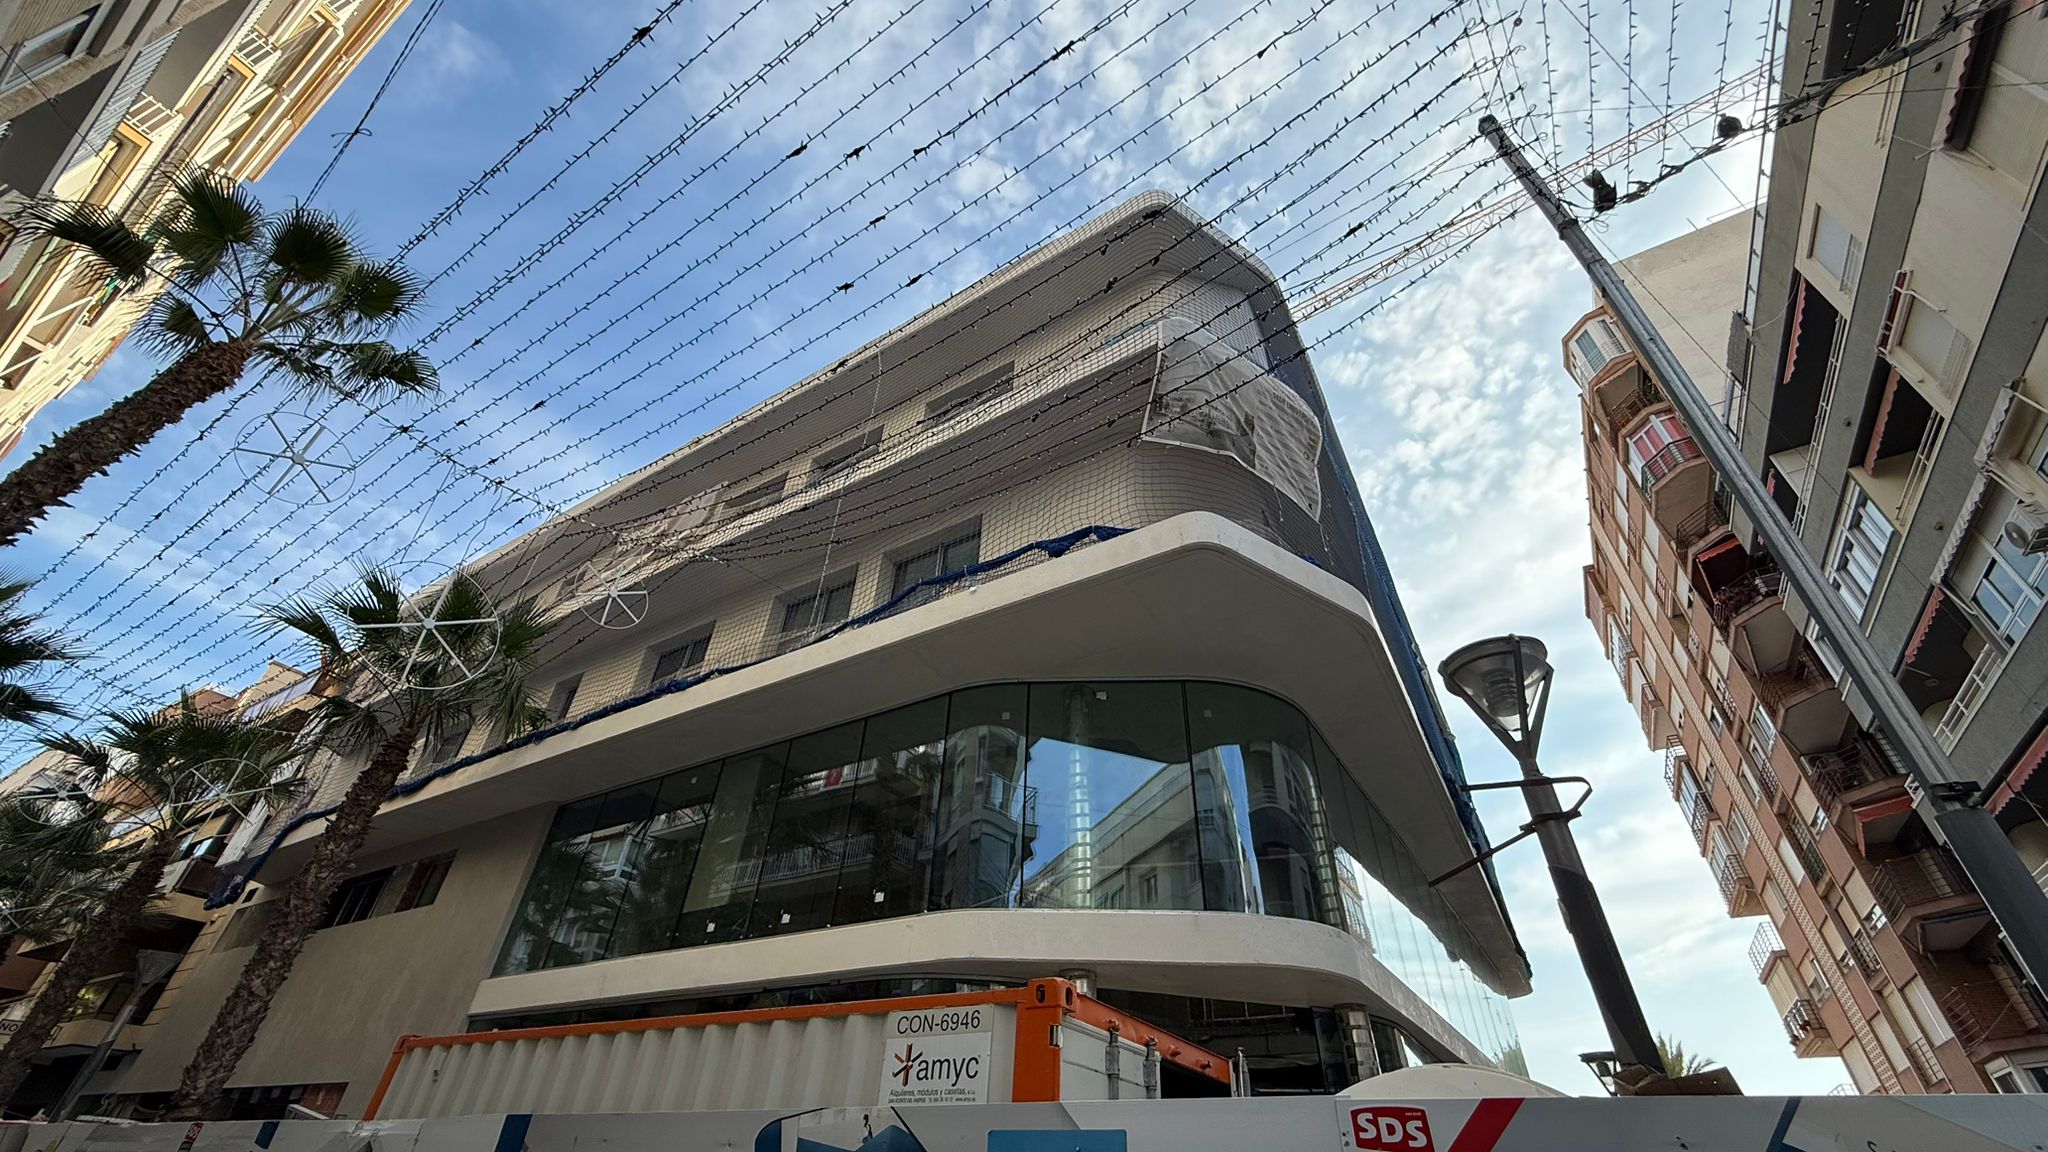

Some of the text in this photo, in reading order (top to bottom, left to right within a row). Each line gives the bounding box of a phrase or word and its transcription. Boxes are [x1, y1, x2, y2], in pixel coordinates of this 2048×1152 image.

[897, 1009, 981, 1035] CON-6946
[916, 1056, 980, 1087] amyc
[1356, 1112, 1428, 1148] SDS
